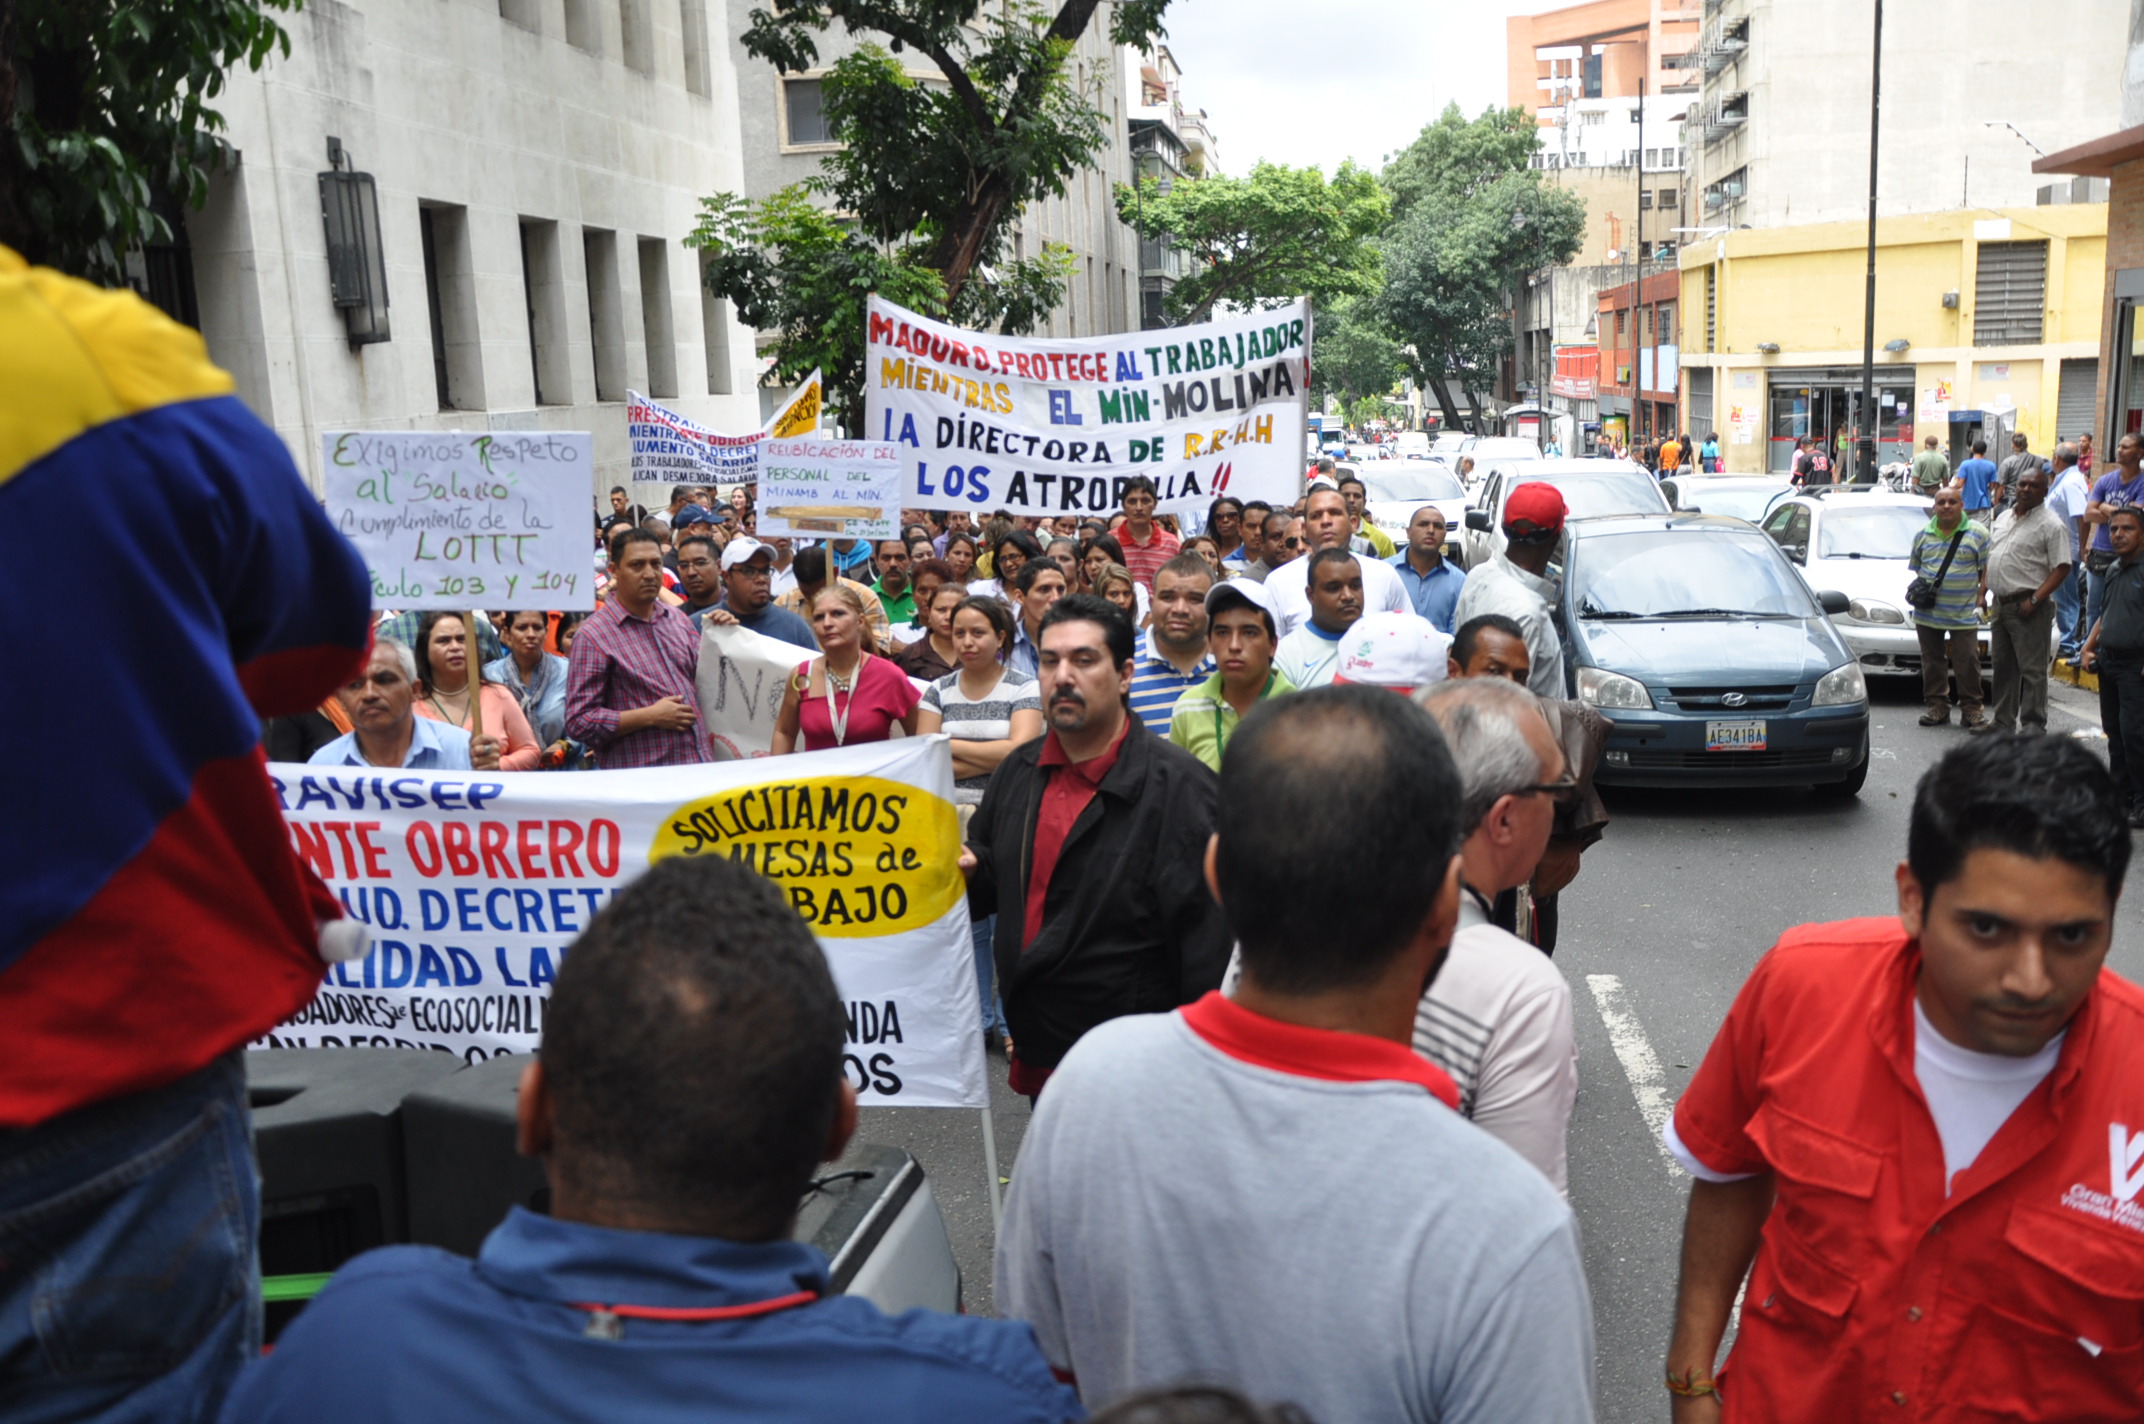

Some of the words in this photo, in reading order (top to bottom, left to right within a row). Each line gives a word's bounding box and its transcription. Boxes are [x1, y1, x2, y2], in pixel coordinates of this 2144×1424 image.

[998, 350, 1108, 382] PROTEGE
[1115, 350, 1143, 383] AL
[1144, 319, 1304, 377] TRABAJADOR
[1048, 389, 1083, 426] EL
[884, 407, 919, 448] LA
[1128, 436, 1164, 463] DE
[470, 435, 579, 475] Respeto
[873, 447, 897, 460] DEL
[357, 469, 394, 504] al
[766, 466, 830, 481] PERSONAL
[846, 471, 872, 482] DEL
[917, 461, 991, 503] LOS
[832, 489, 849, 500] AL
[478, 502, 507, 530] de
[522, 498, 553, 530] la
[414, 531, 539, 565] LOTTT
[434, 575, 486, 597] 103
[531, 569, 578, 596] 104
[1710, 728, 1763, 745] AE341BA
[672, 784, 908, 855] SOLICITAMOS
[405, 818, 621, 880] OBRERO
[876, 841, 923, 871] de
[418, 887, 622, 933] DECRET
[790, 882, 908, 926] BAJO
